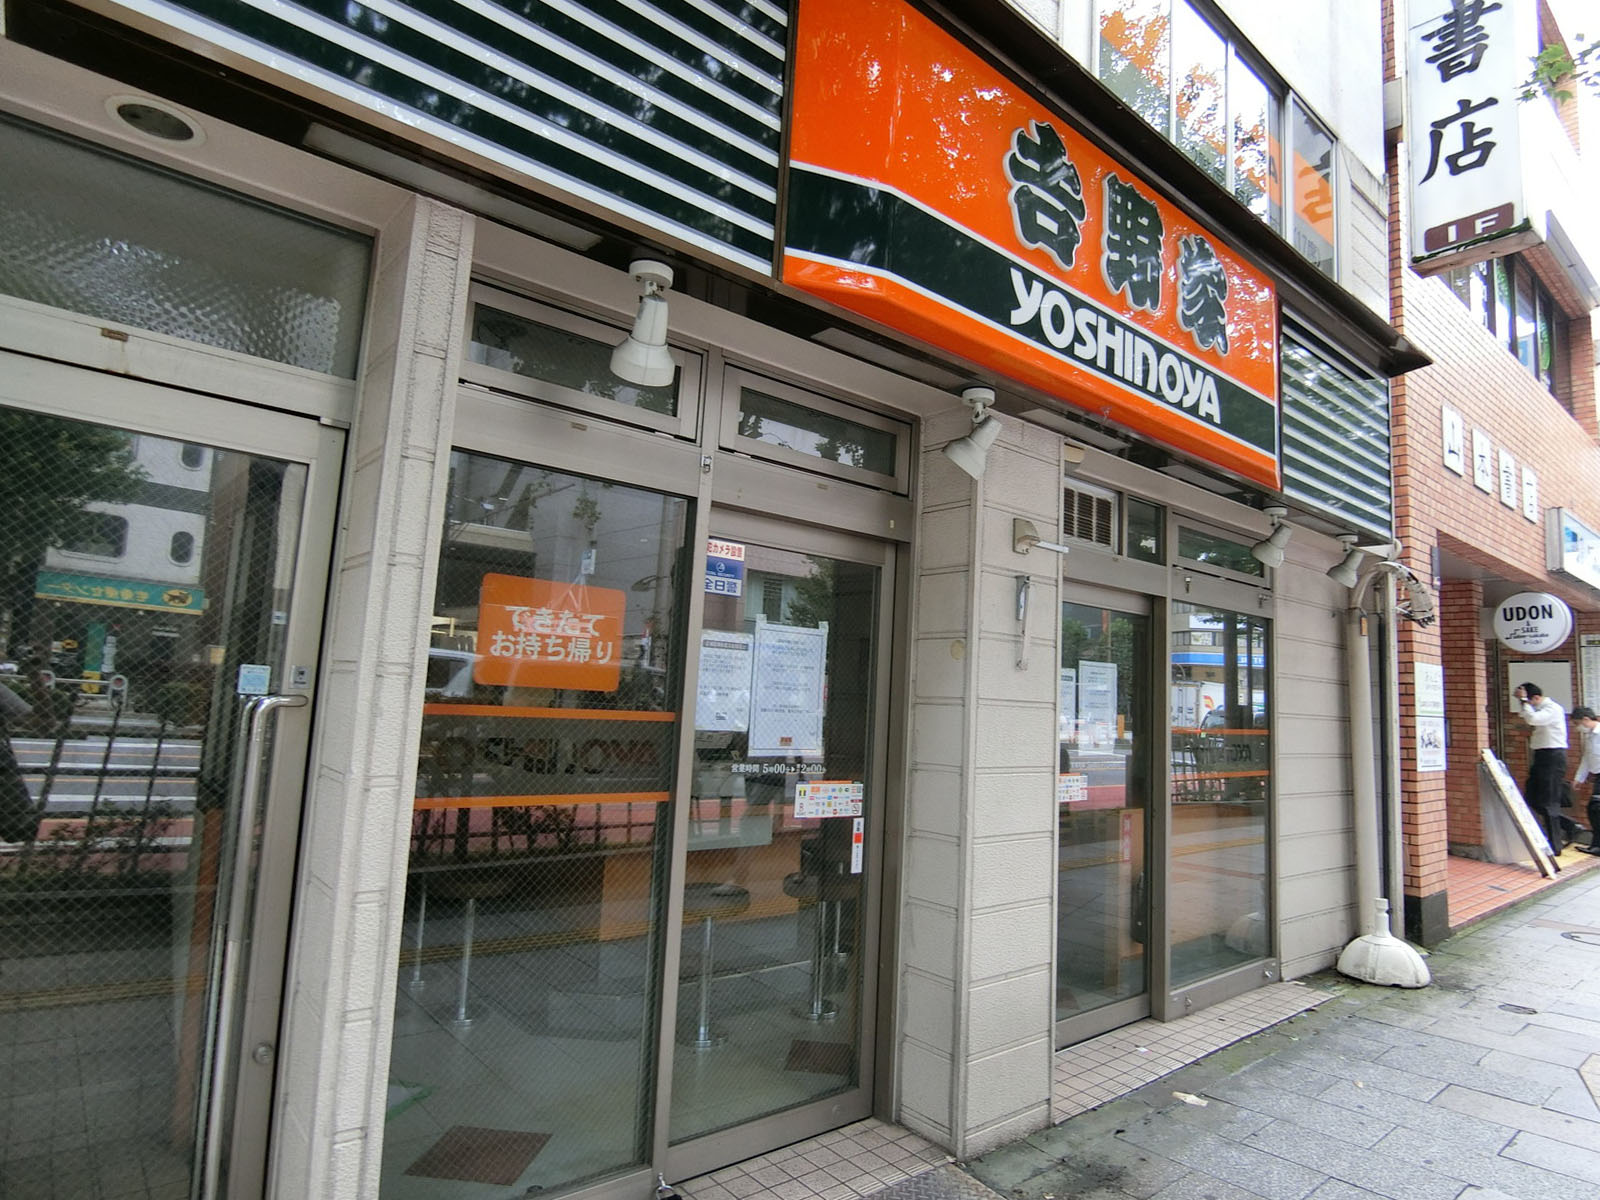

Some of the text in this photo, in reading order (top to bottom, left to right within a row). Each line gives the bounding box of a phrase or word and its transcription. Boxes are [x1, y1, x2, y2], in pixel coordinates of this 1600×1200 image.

[1418, 0, 1503, 186] 書店
[1004, 118, 1229, 357] 吉野家
[1010, 266, 1222, 426] YOSHINOYA
[489, 630, 613, 664] お持ち帰り
[505, 606, 606, 637] できたて
[1503, 604, 1553, 622] UDON
